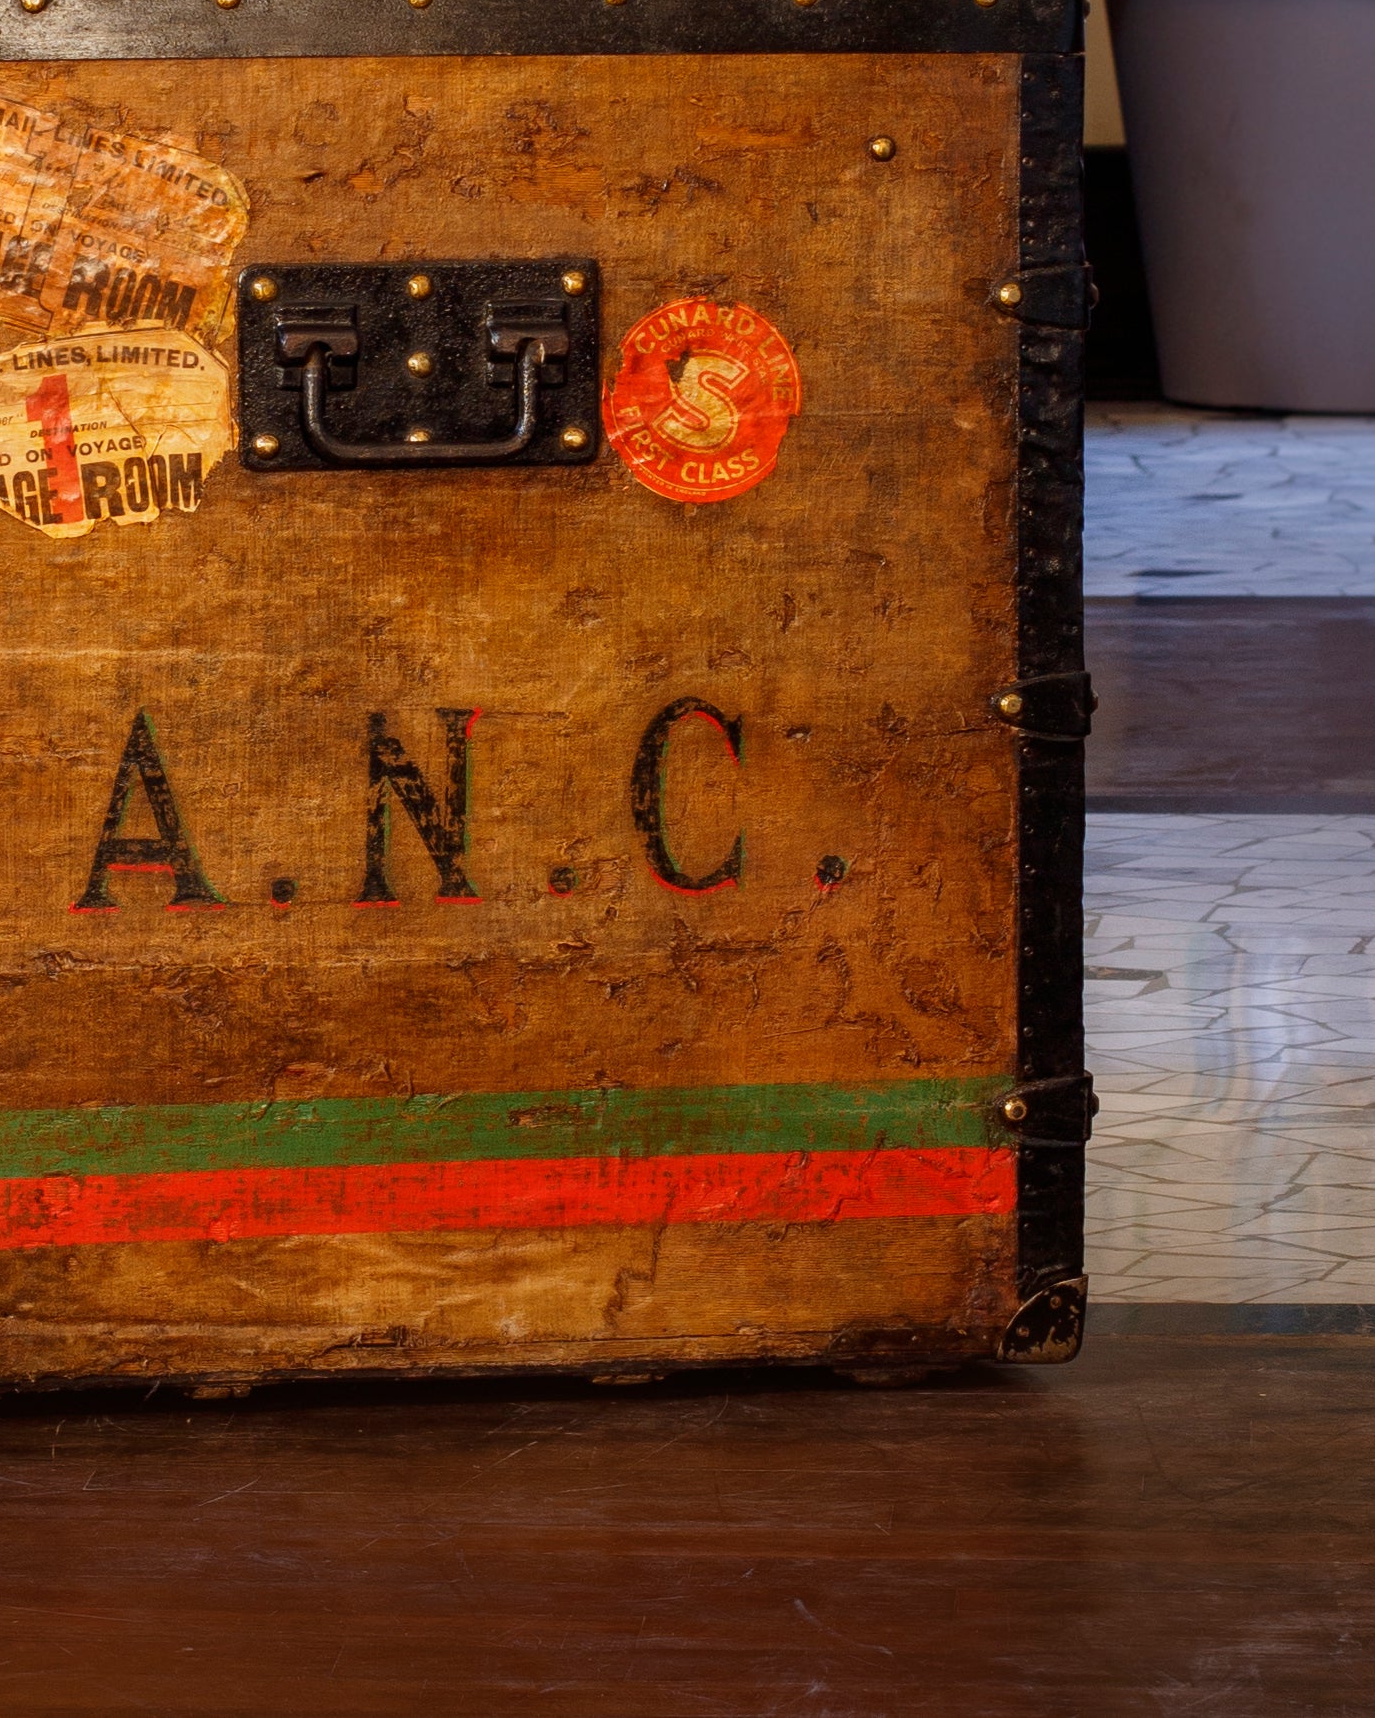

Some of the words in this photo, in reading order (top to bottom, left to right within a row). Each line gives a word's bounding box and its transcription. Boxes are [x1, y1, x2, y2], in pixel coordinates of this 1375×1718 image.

[62, 253, 197, 330] ROOM
[12, 346, 92, 371] LINES,
[96, 345, 206, 372] LIMITED.
[634, 304, 756, 355] CUNARD
[758, 336, 793, 402] LINE
[26, 374, 84, 525] 1
[26, 447, 54, 464] ON
[620, 405, 674, 471] FIRST
[680, 448, 761, 484] CLASS
[80, 452, 204, 521] ROOM
